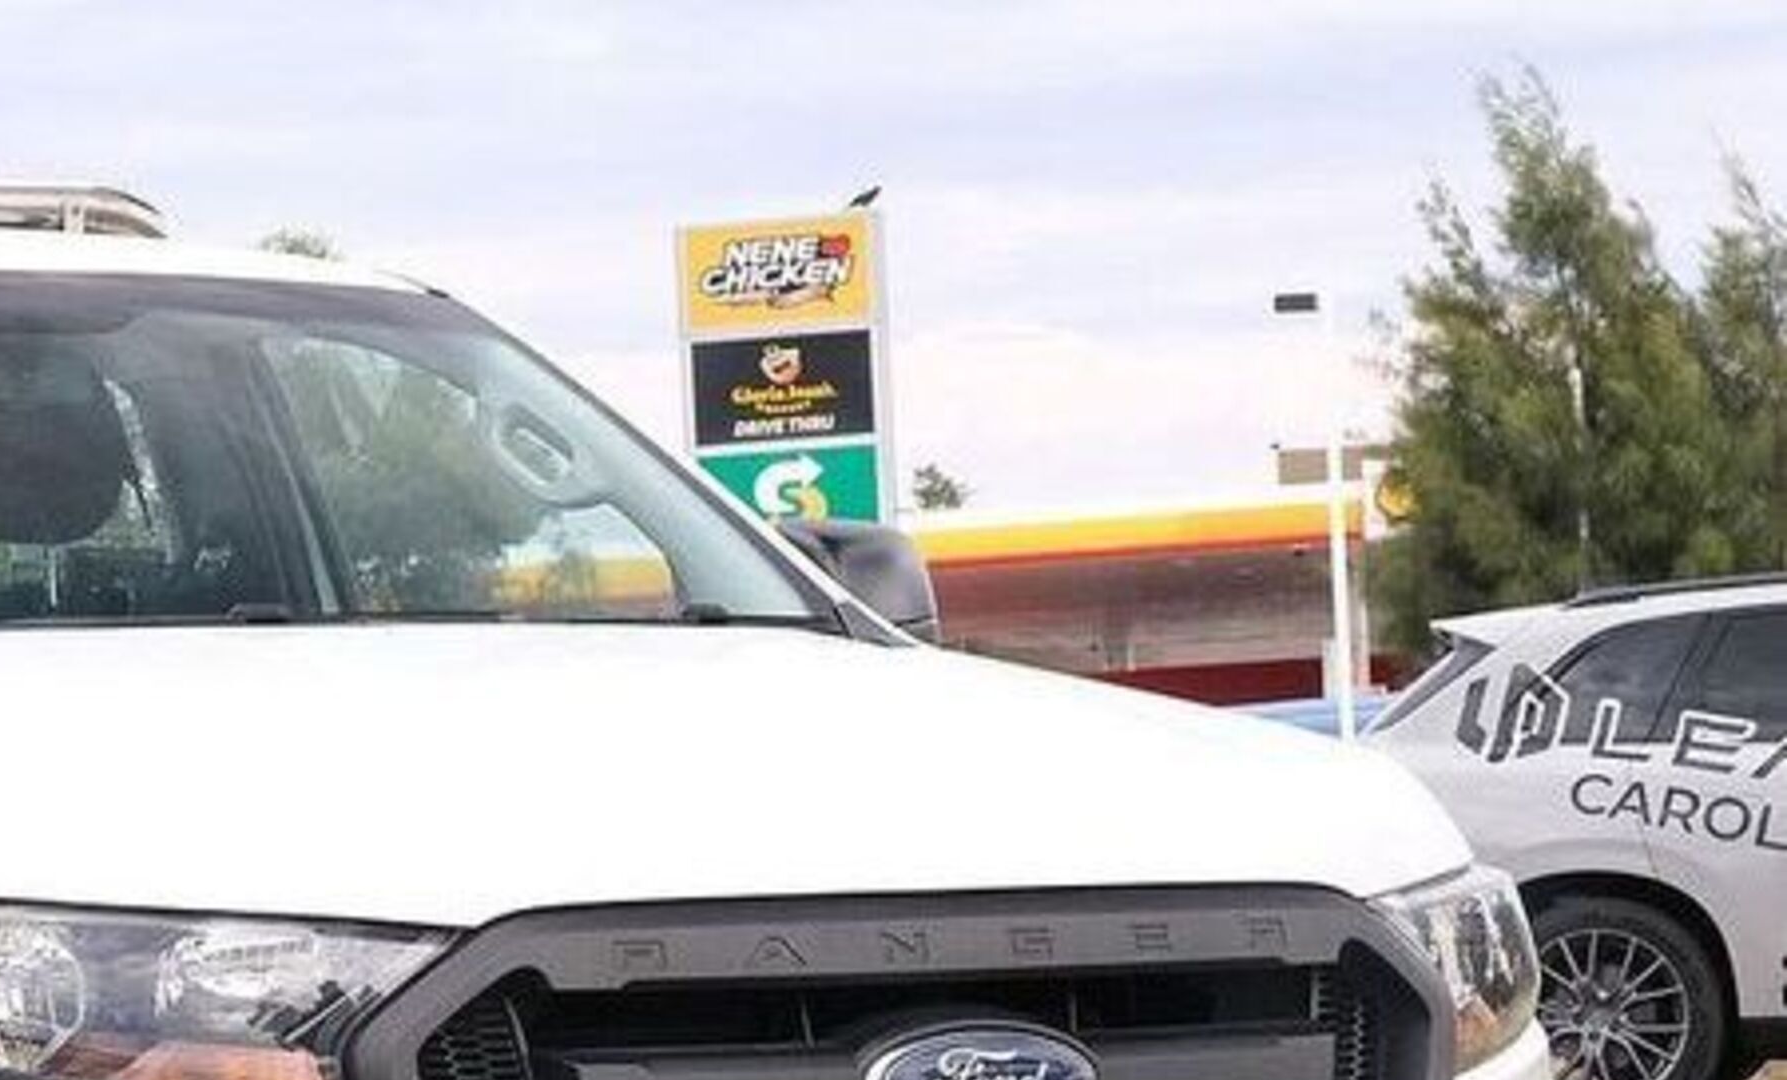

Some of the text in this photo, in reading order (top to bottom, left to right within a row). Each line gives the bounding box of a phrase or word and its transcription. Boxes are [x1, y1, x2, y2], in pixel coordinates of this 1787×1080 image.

[725, 237, 820, 268] NENE
[700, 257, 852, 297] CHICKEN
[613, 916, 1288, 969] RANGER
